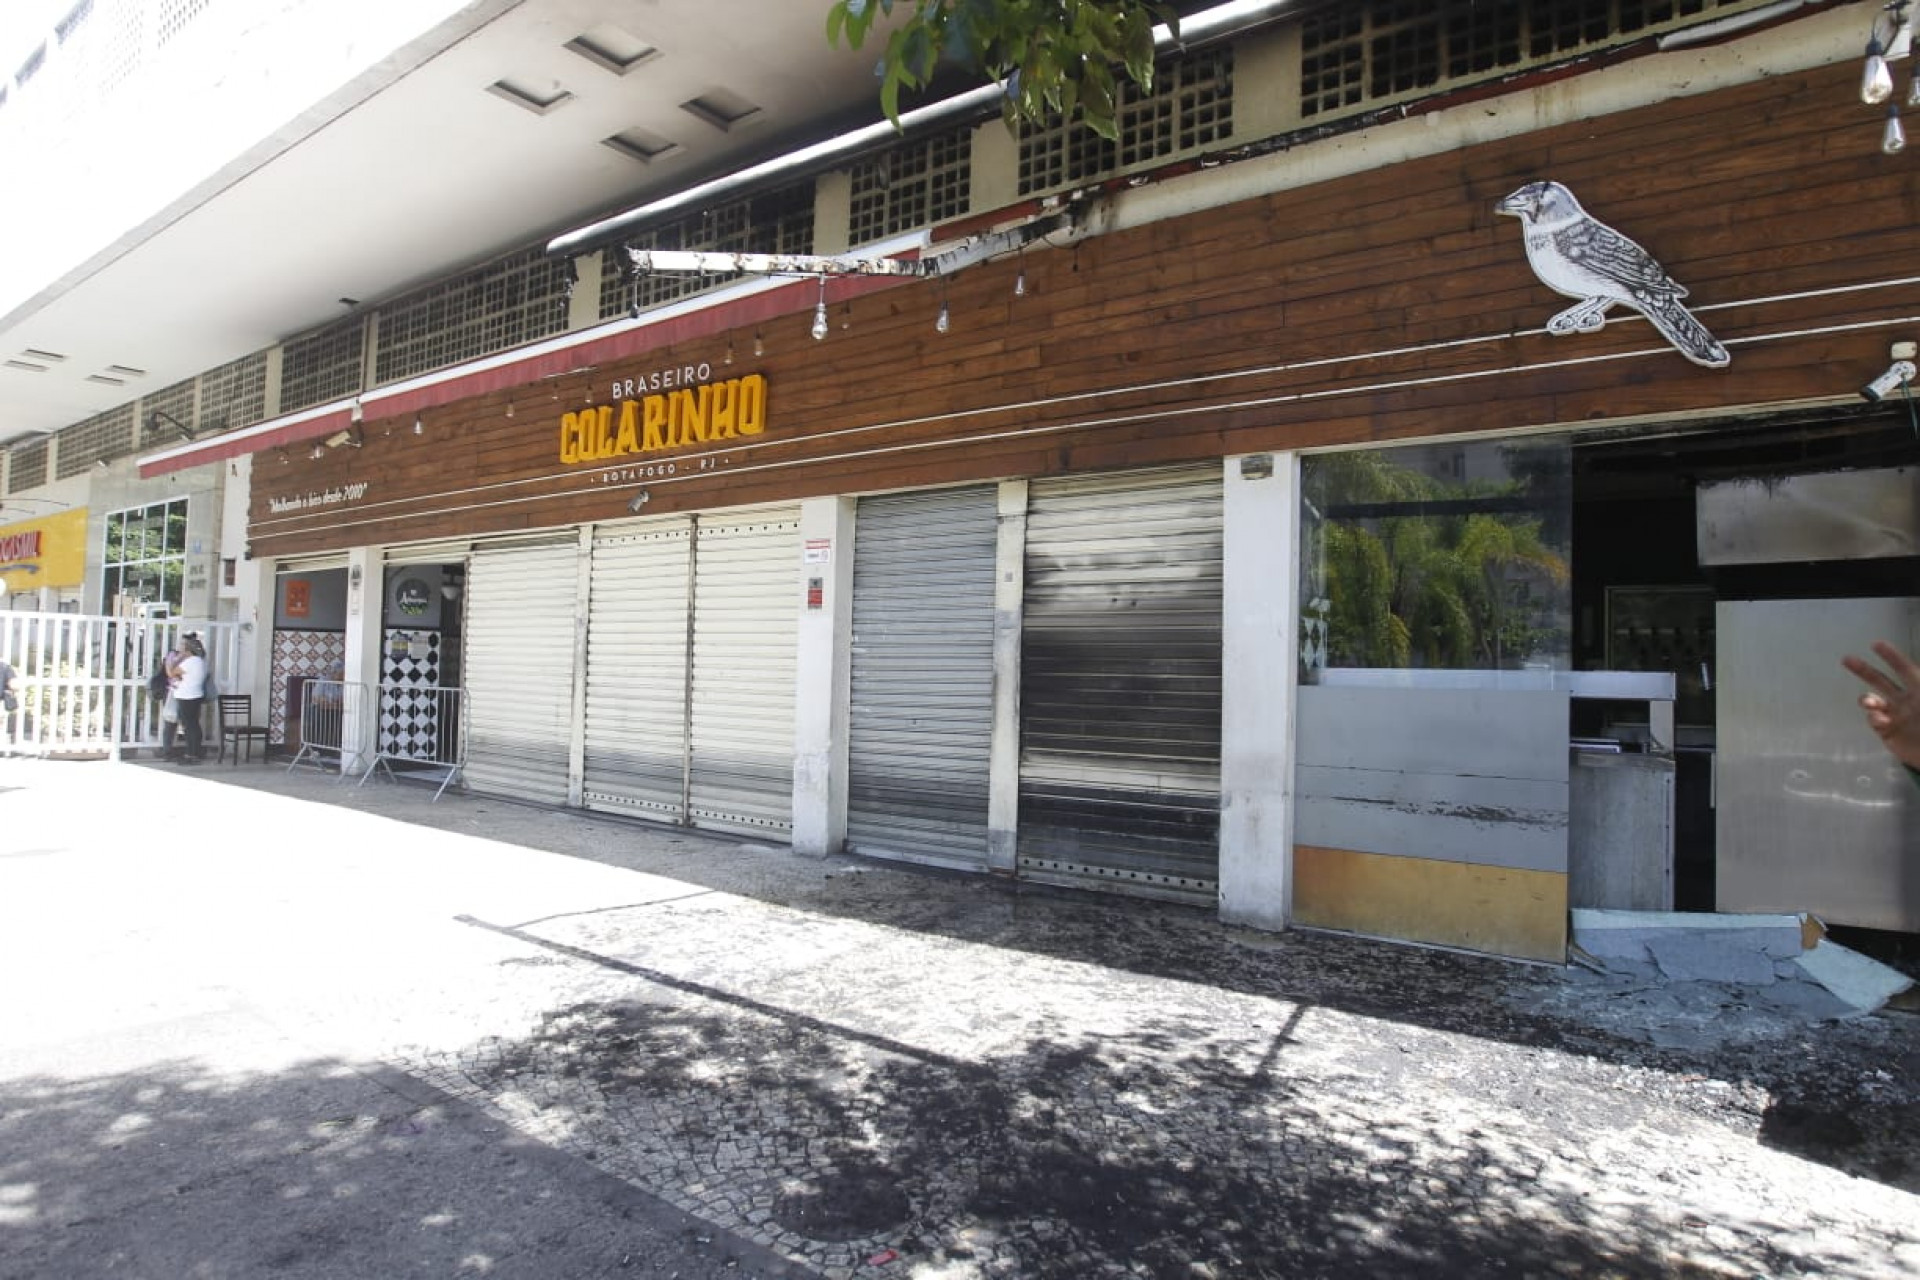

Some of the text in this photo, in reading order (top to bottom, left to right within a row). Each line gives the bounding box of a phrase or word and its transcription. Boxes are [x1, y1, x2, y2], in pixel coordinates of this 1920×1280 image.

[612, 363, 711, 399] BRASEIRO
[560, 373, 768, 464] COLARINHO
[603, 458, 716, 483] BOTAFOGO RJ
